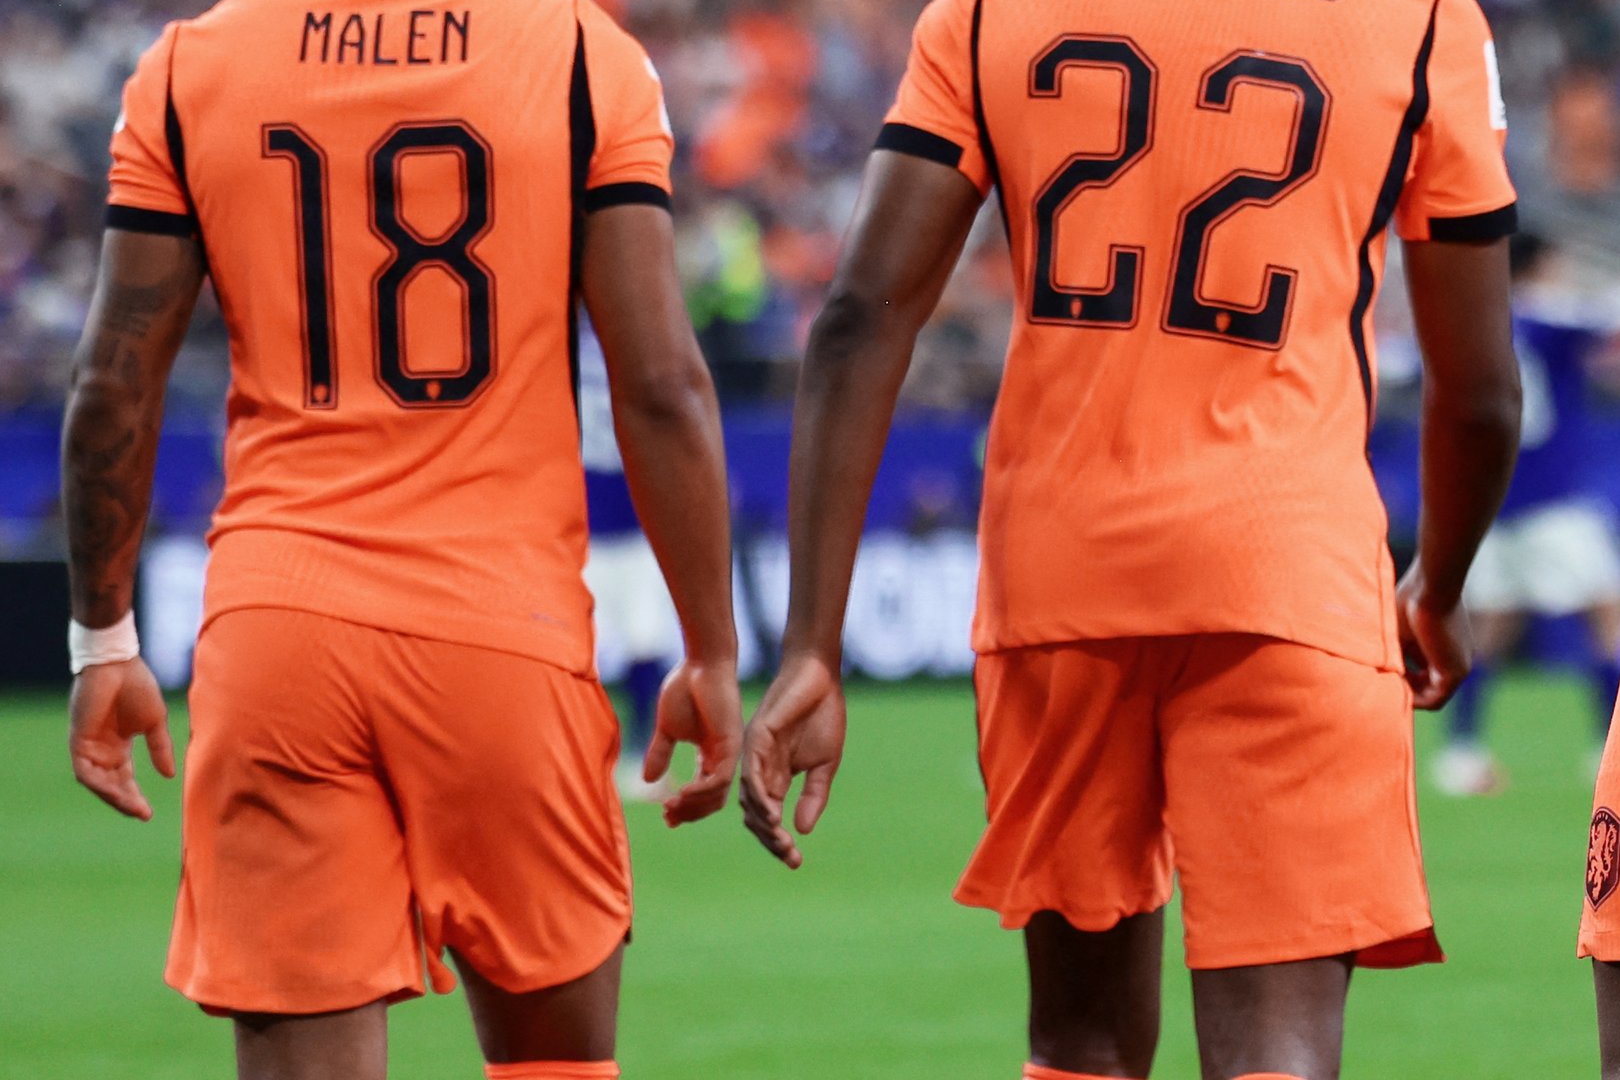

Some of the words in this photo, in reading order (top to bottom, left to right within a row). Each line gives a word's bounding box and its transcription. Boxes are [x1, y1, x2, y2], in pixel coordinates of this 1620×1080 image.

[299, 10, 470, 65] MALEN
[261, 119, 498, 410] 18
[1027, 33, 1333, 352] 22
